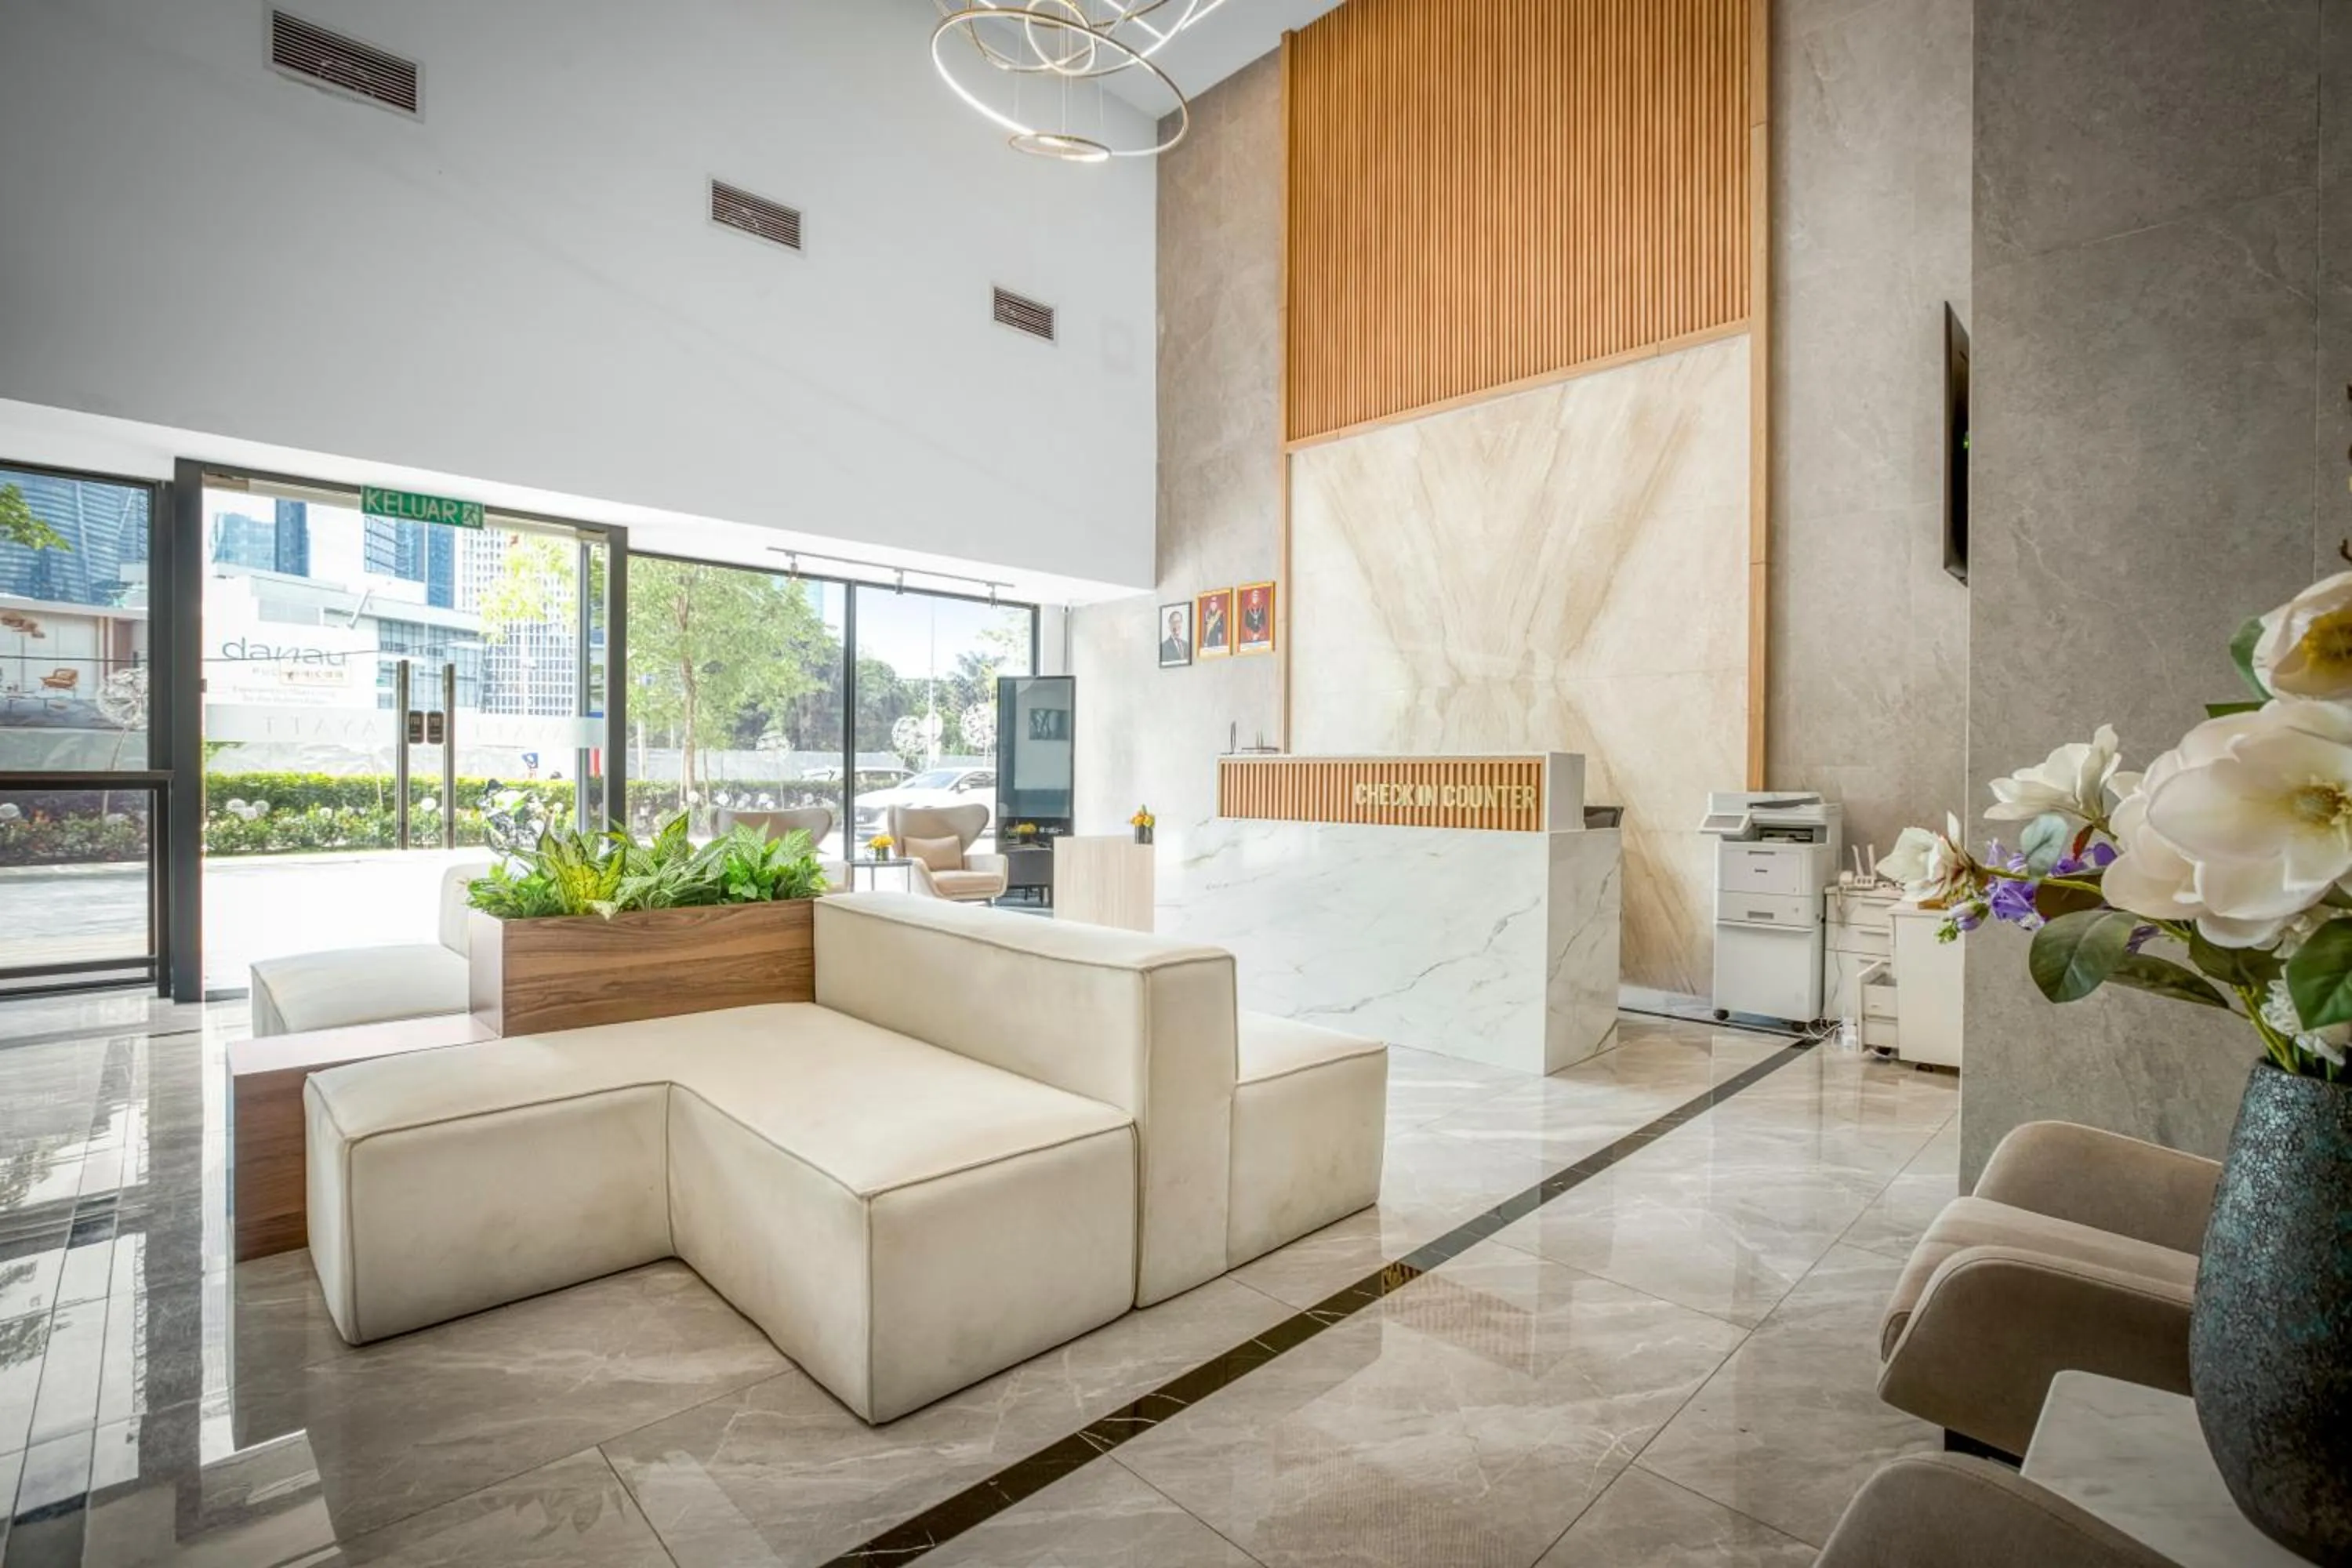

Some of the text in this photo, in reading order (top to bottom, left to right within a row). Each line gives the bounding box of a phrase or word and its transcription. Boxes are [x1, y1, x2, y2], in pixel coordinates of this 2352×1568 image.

[366, 488, 457, 524] KELUAR
[222, 637, 346, 666] danau
[1356, 782, 1535, 811] CHECK IN COUNTER
